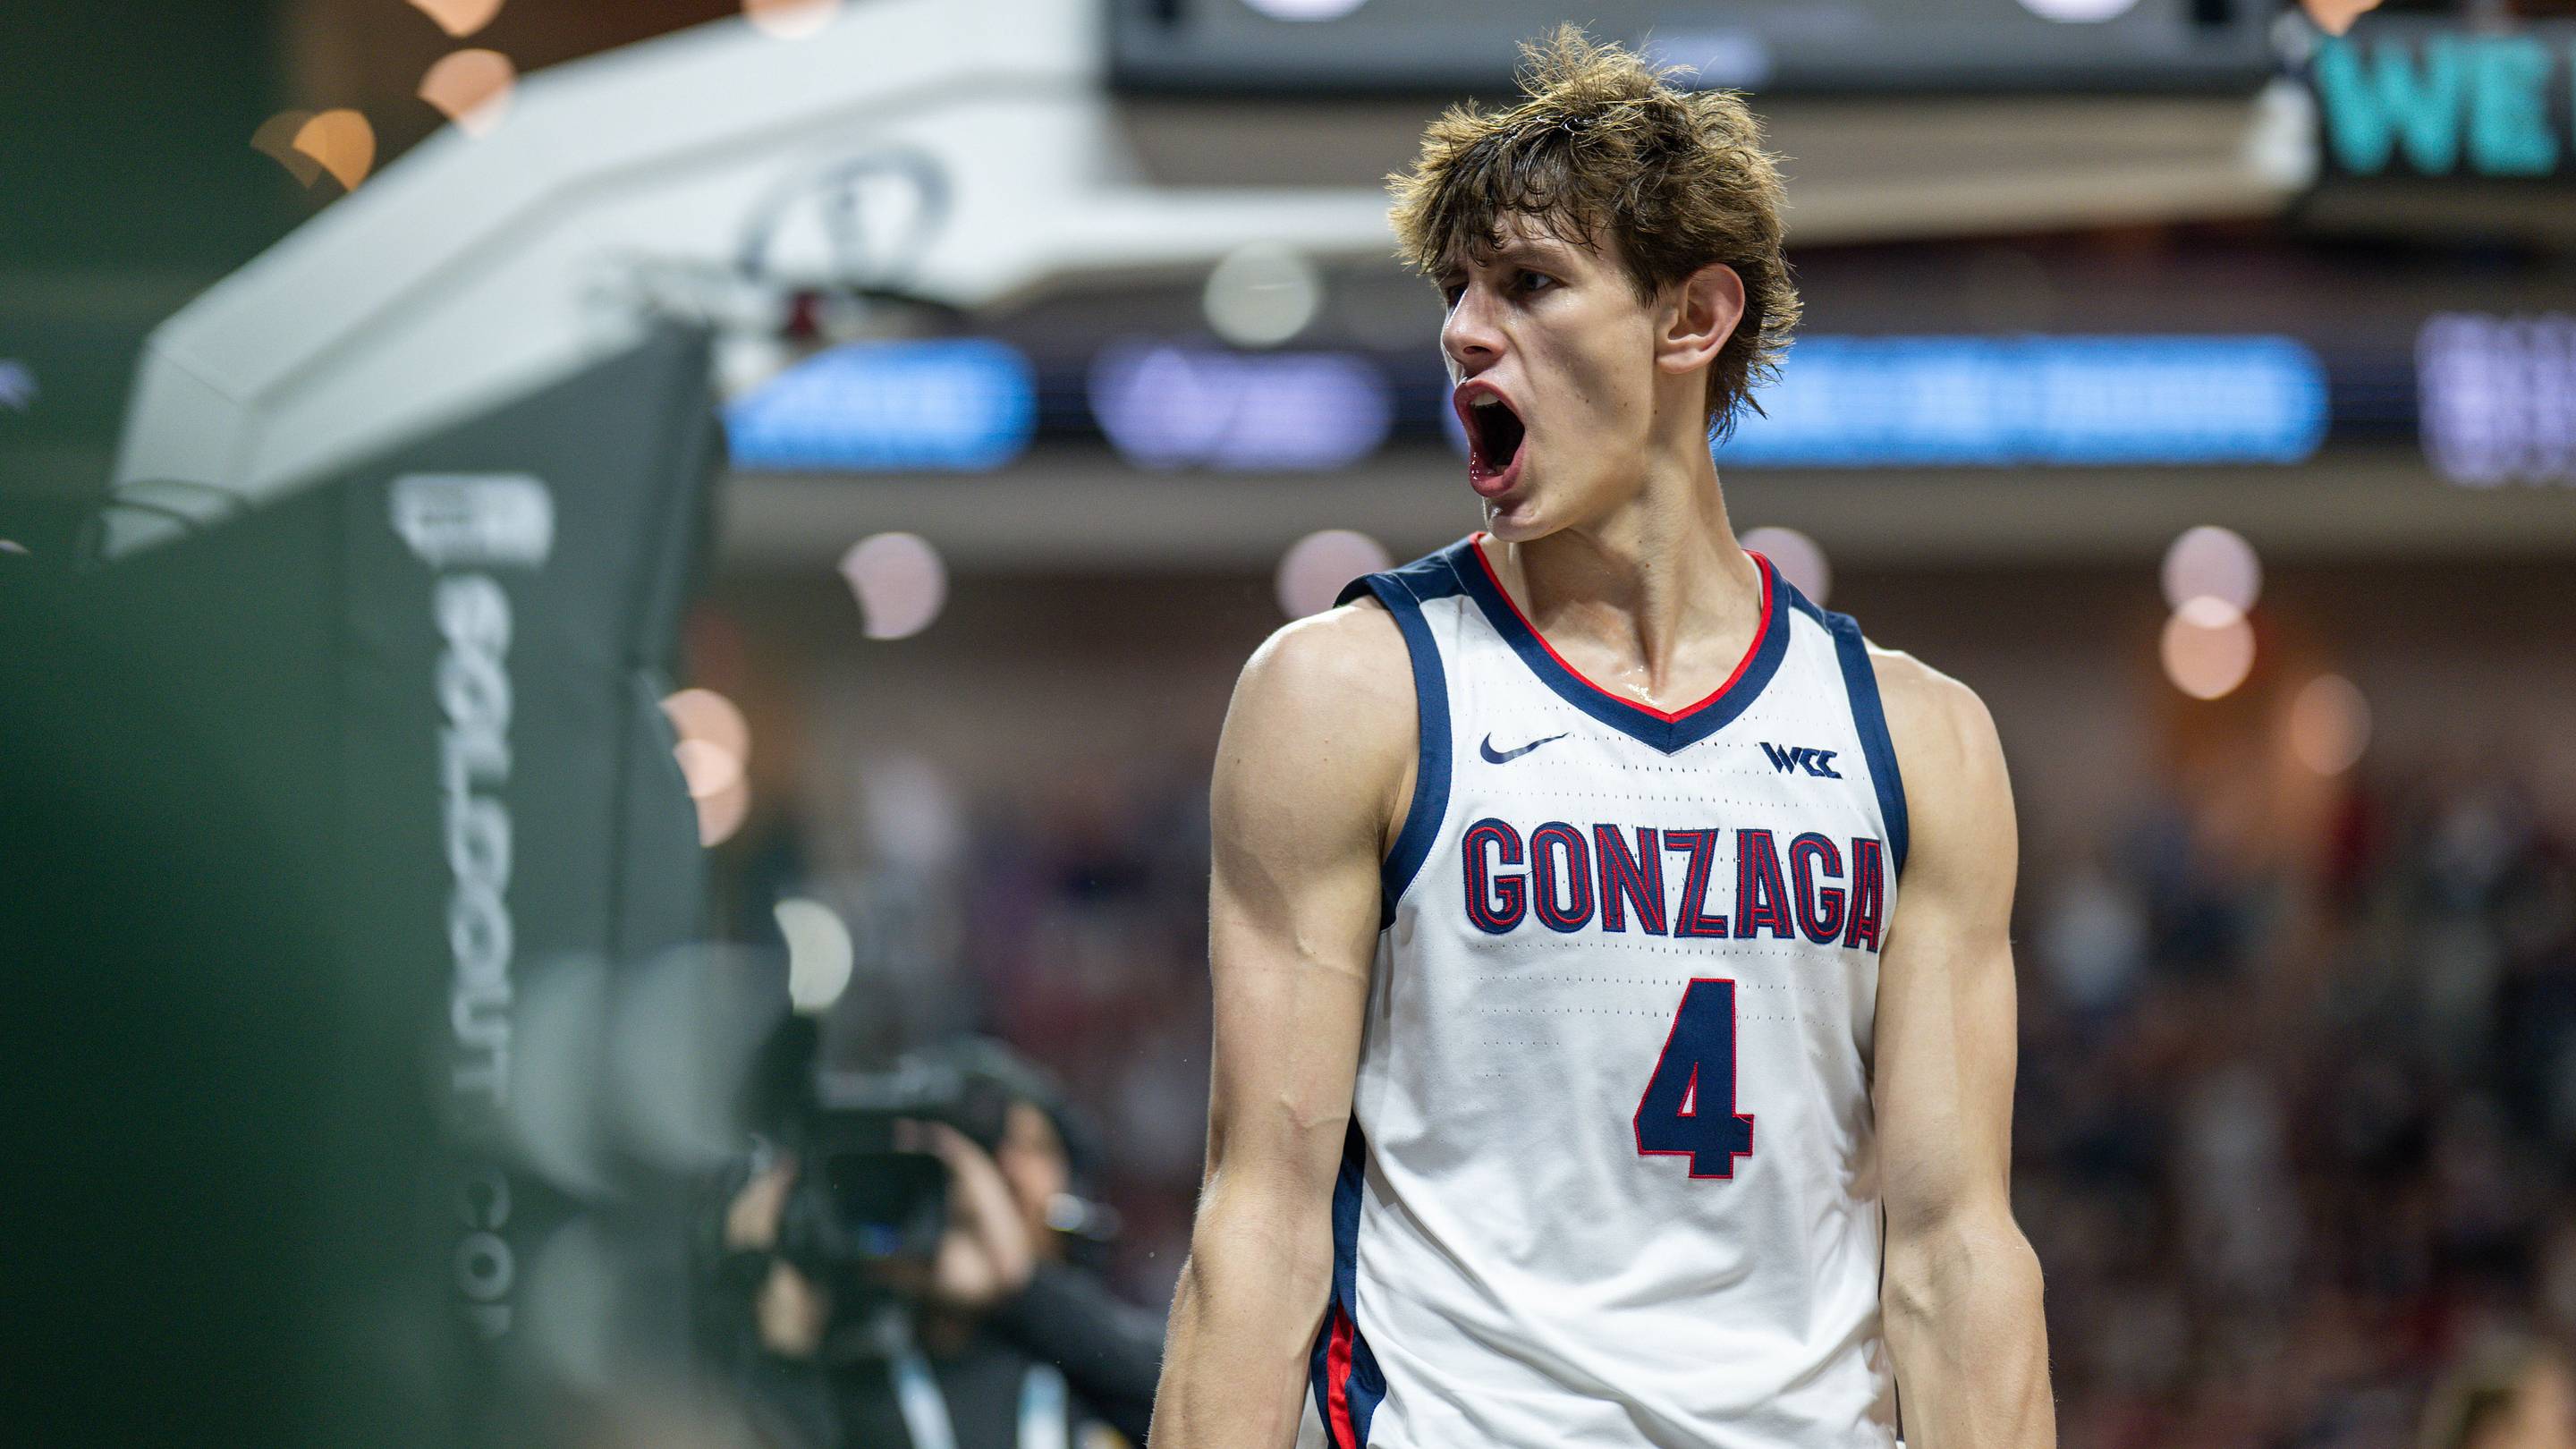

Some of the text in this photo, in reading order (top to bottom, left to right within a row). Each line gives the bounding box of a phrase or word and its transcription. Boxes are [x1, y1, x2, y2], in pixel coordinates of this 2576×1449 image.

[2318, 34, 2576, 175] WE
[1759, 741, 1843, 780] WCC
[1462, 818, 1885, 953] GONZAGA
[1632, 977, 1755, 1180] 4
